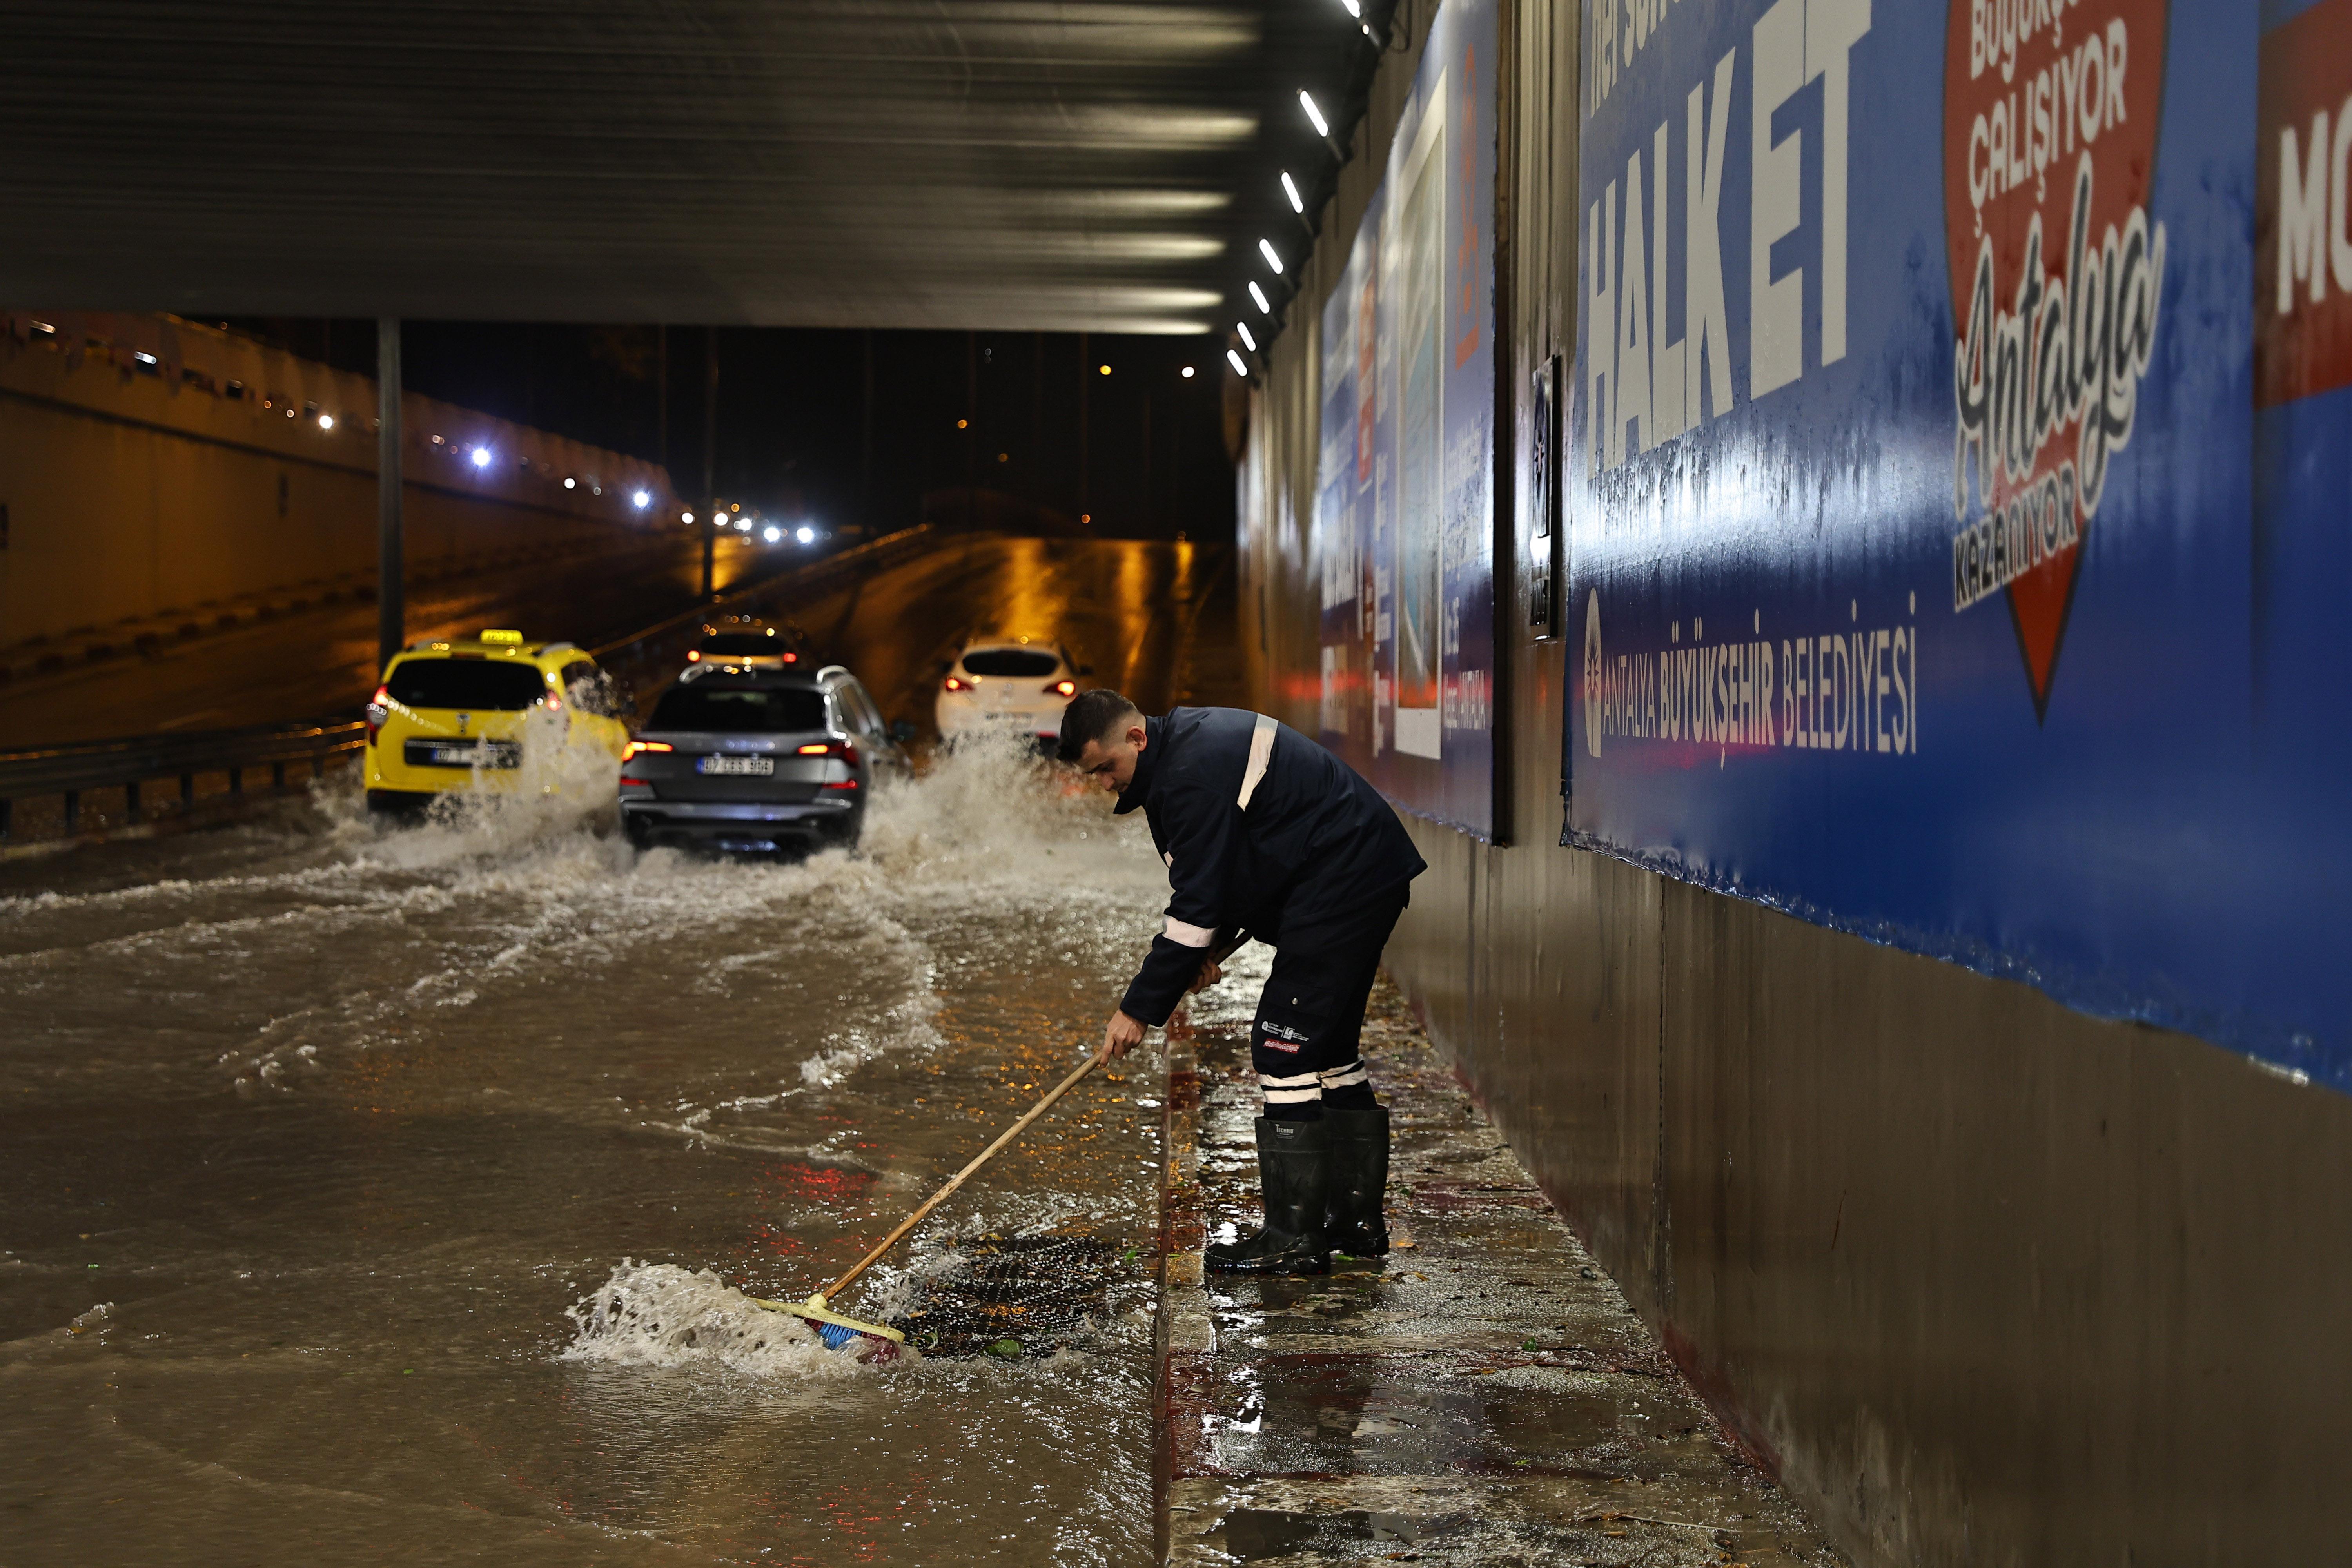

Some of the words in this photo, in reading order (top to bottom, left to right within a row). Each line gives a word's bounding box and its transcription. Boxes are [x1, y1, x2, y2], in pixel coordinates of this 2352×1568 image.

[1969, 16, 2128, 237] ÇALIŞIYOR
[1955, 151, 2166, 521] Antalya
[1954, 461, 2079, 613] KAZANIYOR
[1603, 652, 1656, 739] ANTALYA
[1661, 608, 1775, 771] BÜYÜKŞEHİR
[1783, 590, 1916, 756] BELEDİYESİ
[1275, 1124, 1294, 1134] TECHNO
